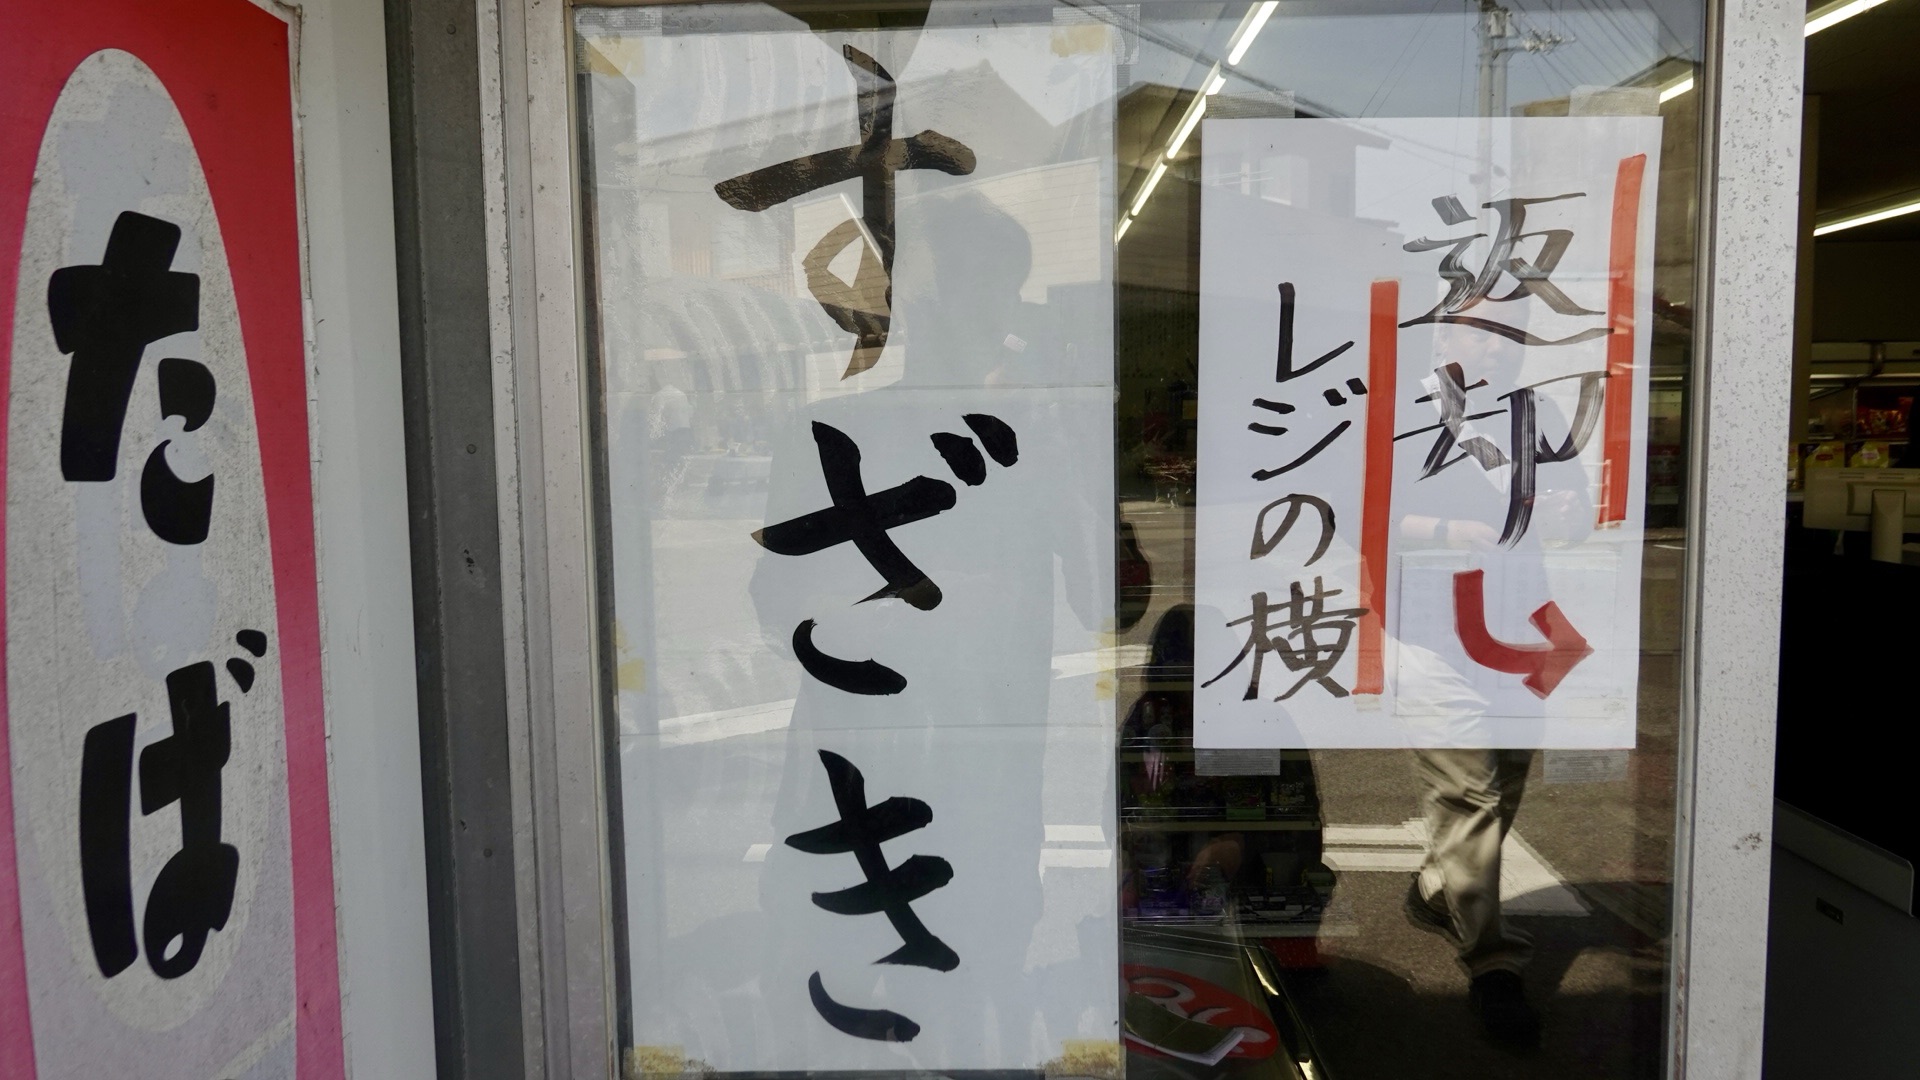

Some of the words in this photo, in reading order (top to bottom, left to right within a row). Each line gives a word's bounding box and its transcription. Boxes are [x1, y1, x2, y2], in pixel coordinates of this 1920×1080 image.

[47, 210, 268, 980] たば
[714, 44, 1019, 1043] すざき
[1200, 281, 1370, 703] レジの横
[1393, 193, 1615, 549] 返却
